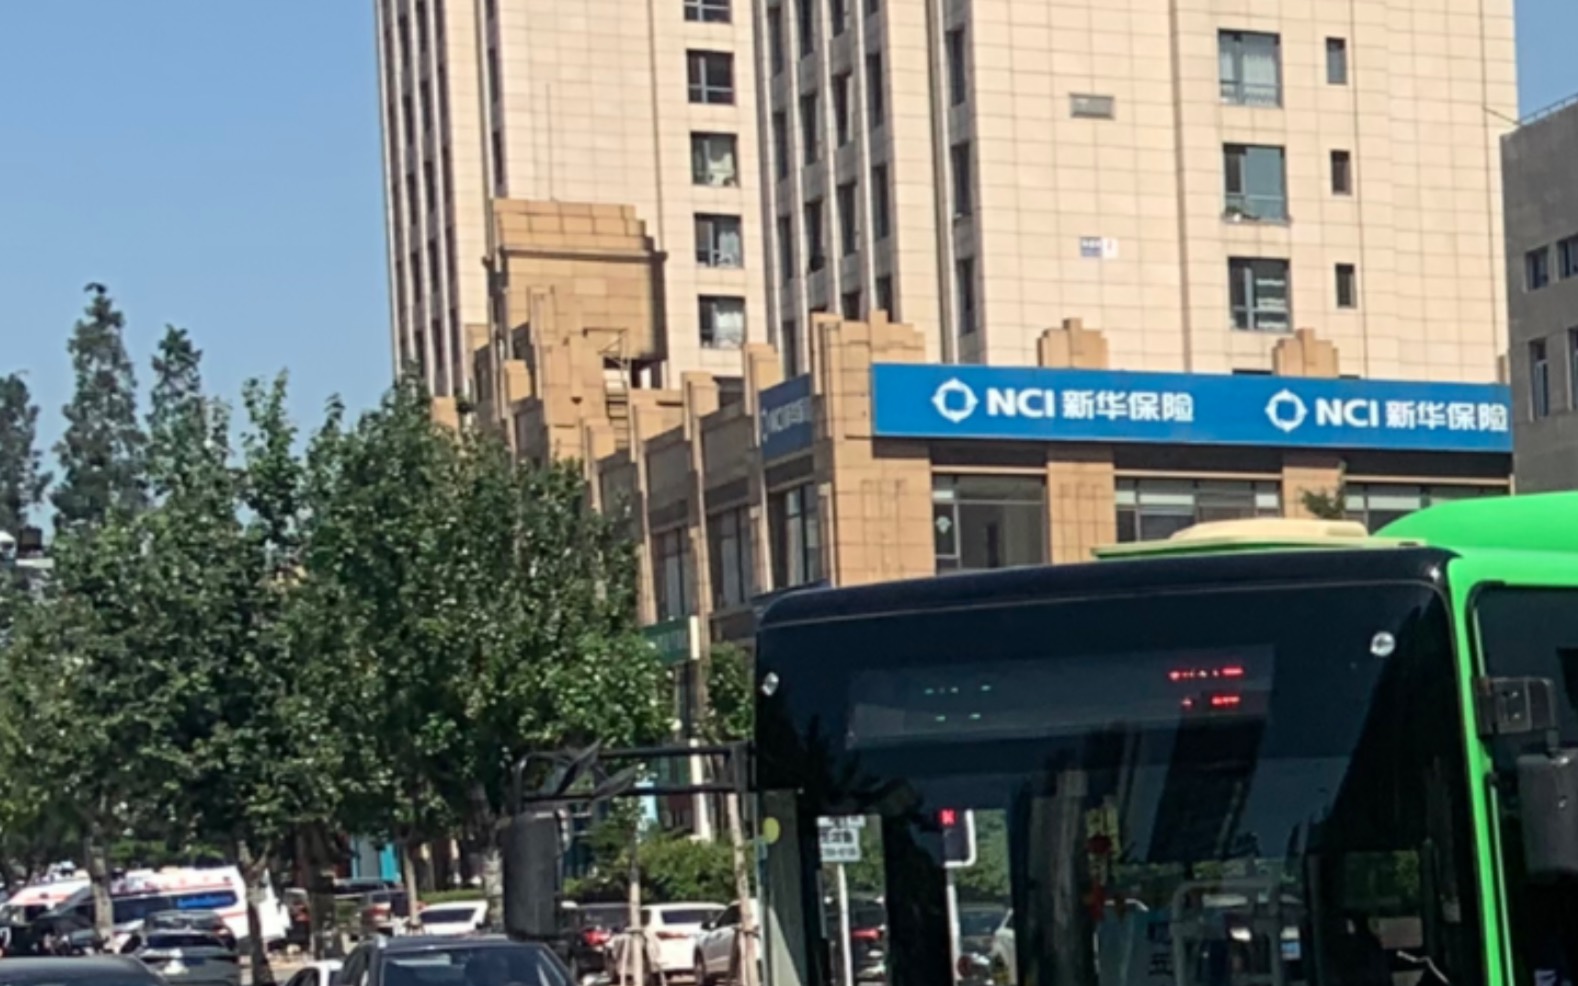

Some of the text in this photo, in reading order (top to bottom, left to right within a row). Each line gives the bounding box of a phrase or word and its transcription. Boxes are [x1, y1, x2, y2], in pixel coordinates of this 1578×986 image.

[987, 387, 1193, 423] NCI 新华保险
[1315, 397, 1507, 432] NCI 新华保险
